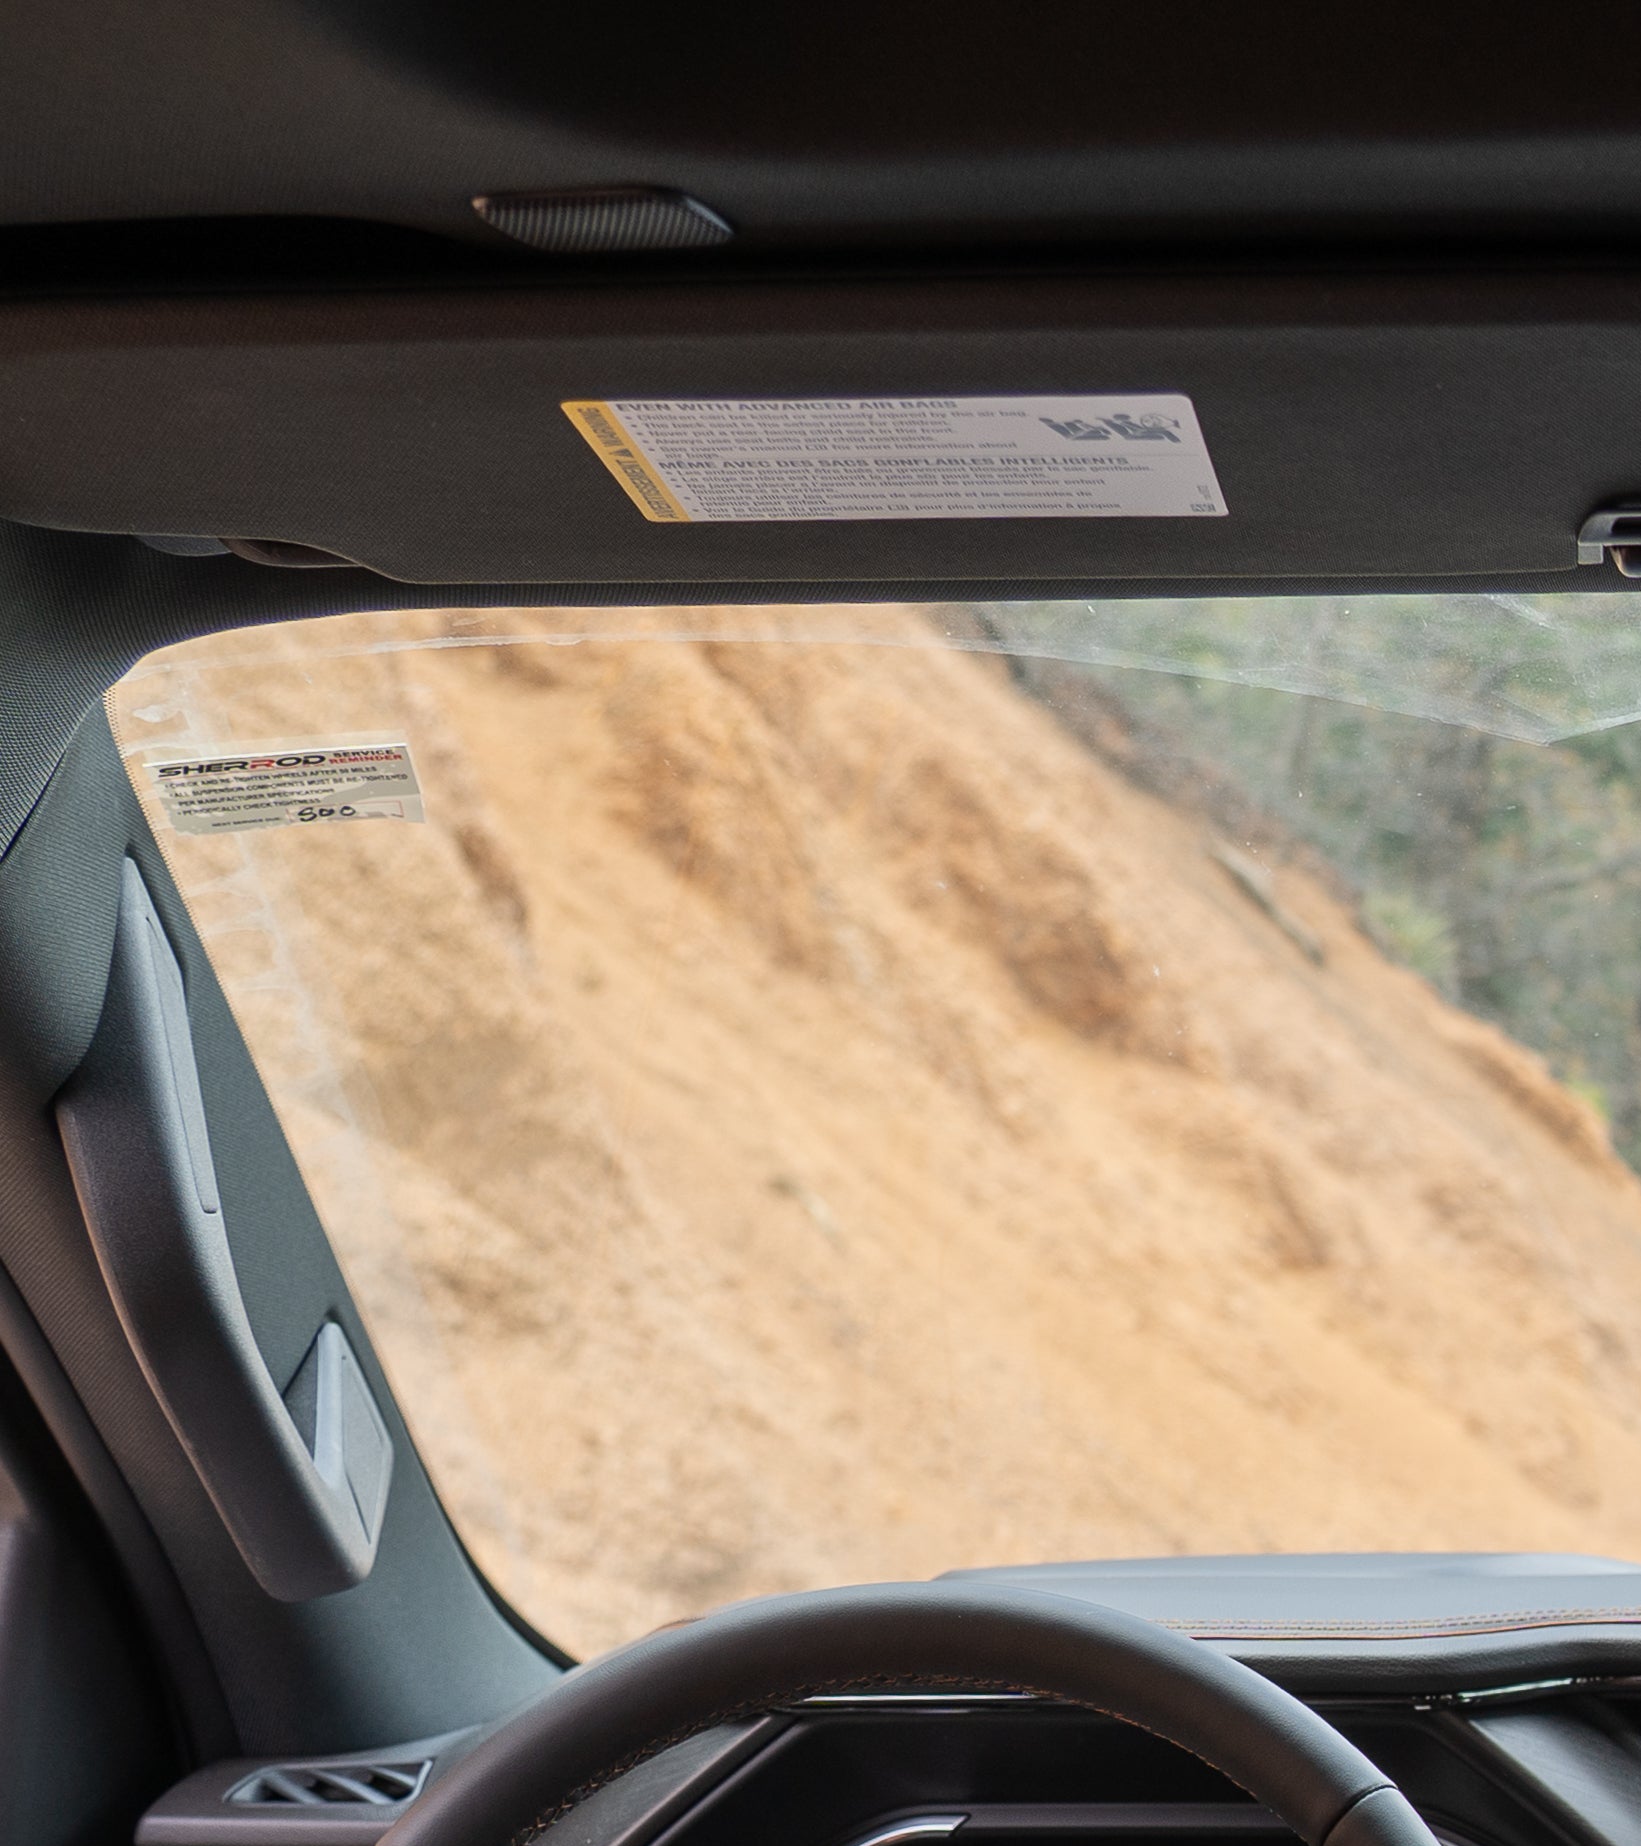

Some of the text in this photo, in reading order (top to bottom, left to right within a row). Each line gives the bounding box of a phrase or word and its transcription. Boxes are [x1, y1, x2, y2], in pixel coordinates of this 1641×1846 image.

[333, 749, 394, 757] SERVICE
[328, 754, 403, 764] REMINDER
[158, 755, 326, 777] SHERROD
